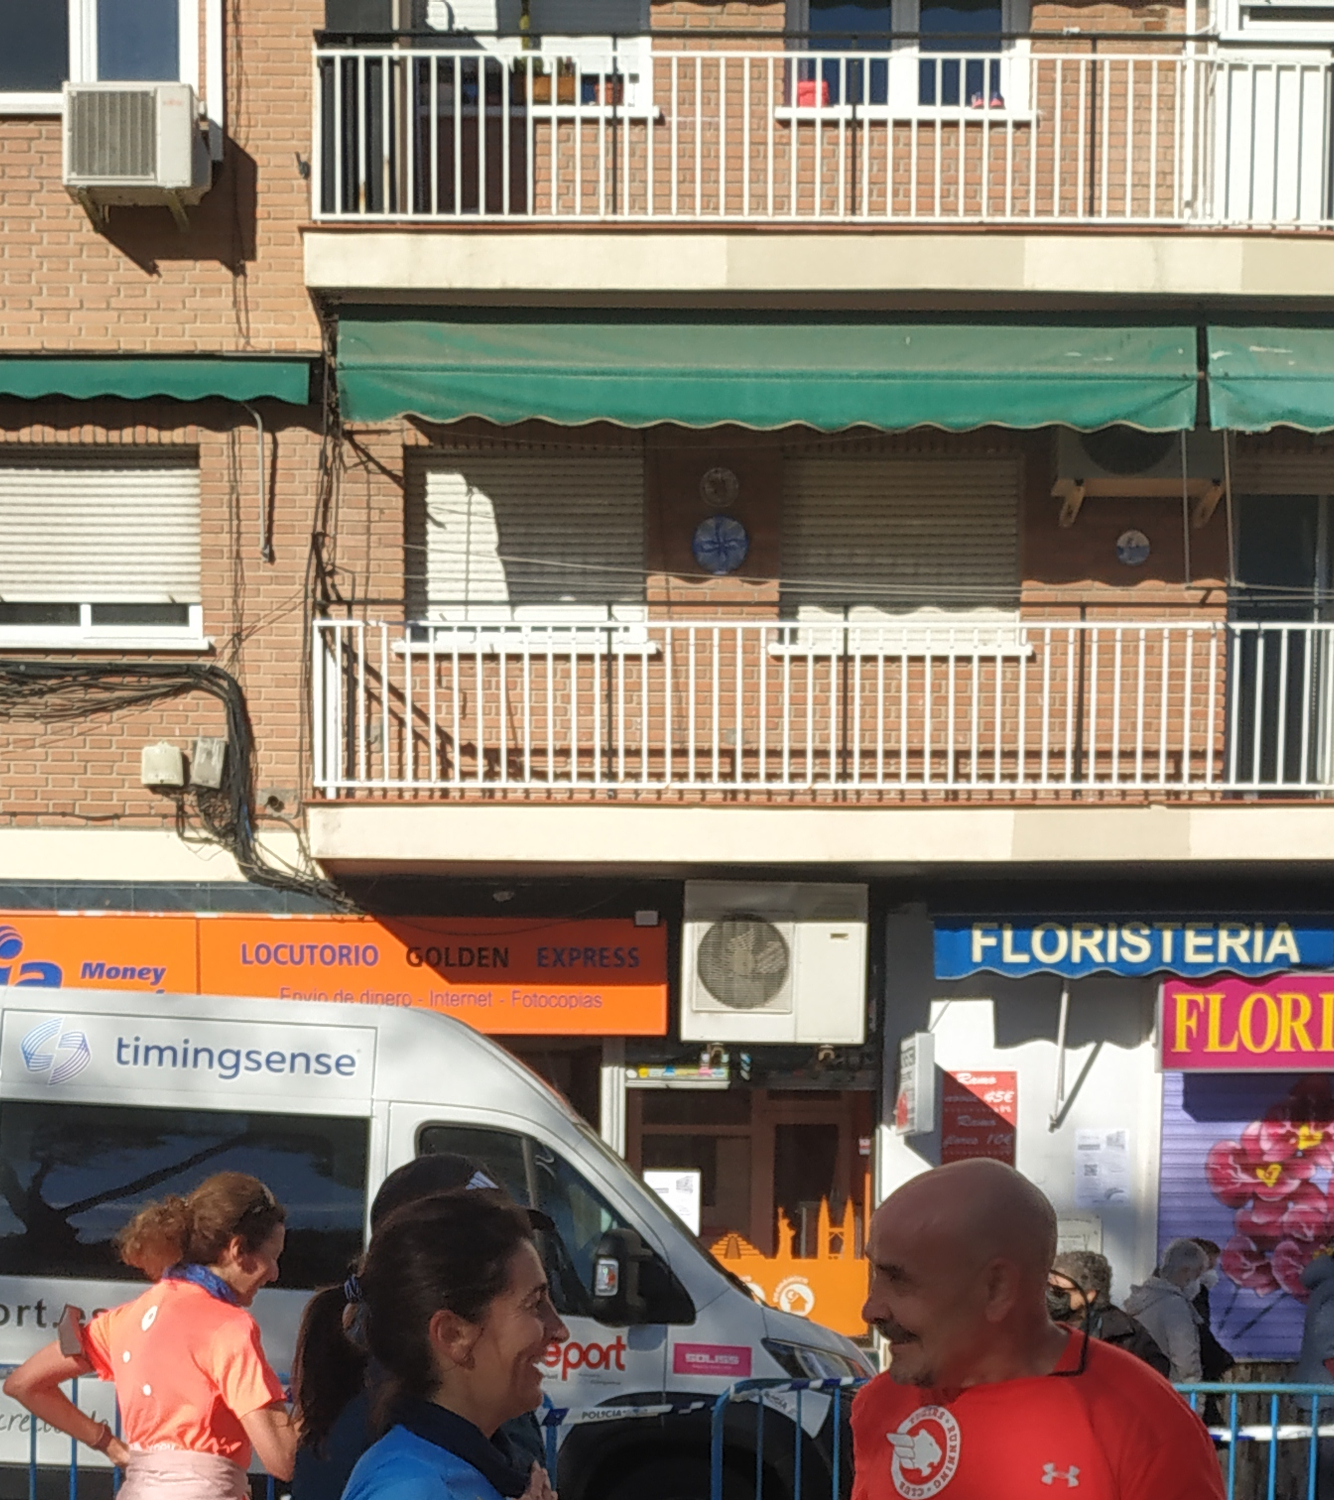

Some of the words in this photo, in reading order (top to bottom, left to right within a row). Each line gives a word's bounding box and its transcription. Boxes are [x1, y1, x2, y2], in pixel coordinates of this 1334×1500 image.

[240, 943, 379, 967] LOCUTORIO
[405, 946, 510, 968] GOLDEN
[536, 946, 641, 968] EXPRESS
[971, 922, 1301, 964] FLORISTERIA
[80, 962, 167, 985] Money
[430, 989, 494, 1008] Internet
[510, 989, 603, 1011] Fotocopias
[116, 1036, 357, 1080] timingsense
